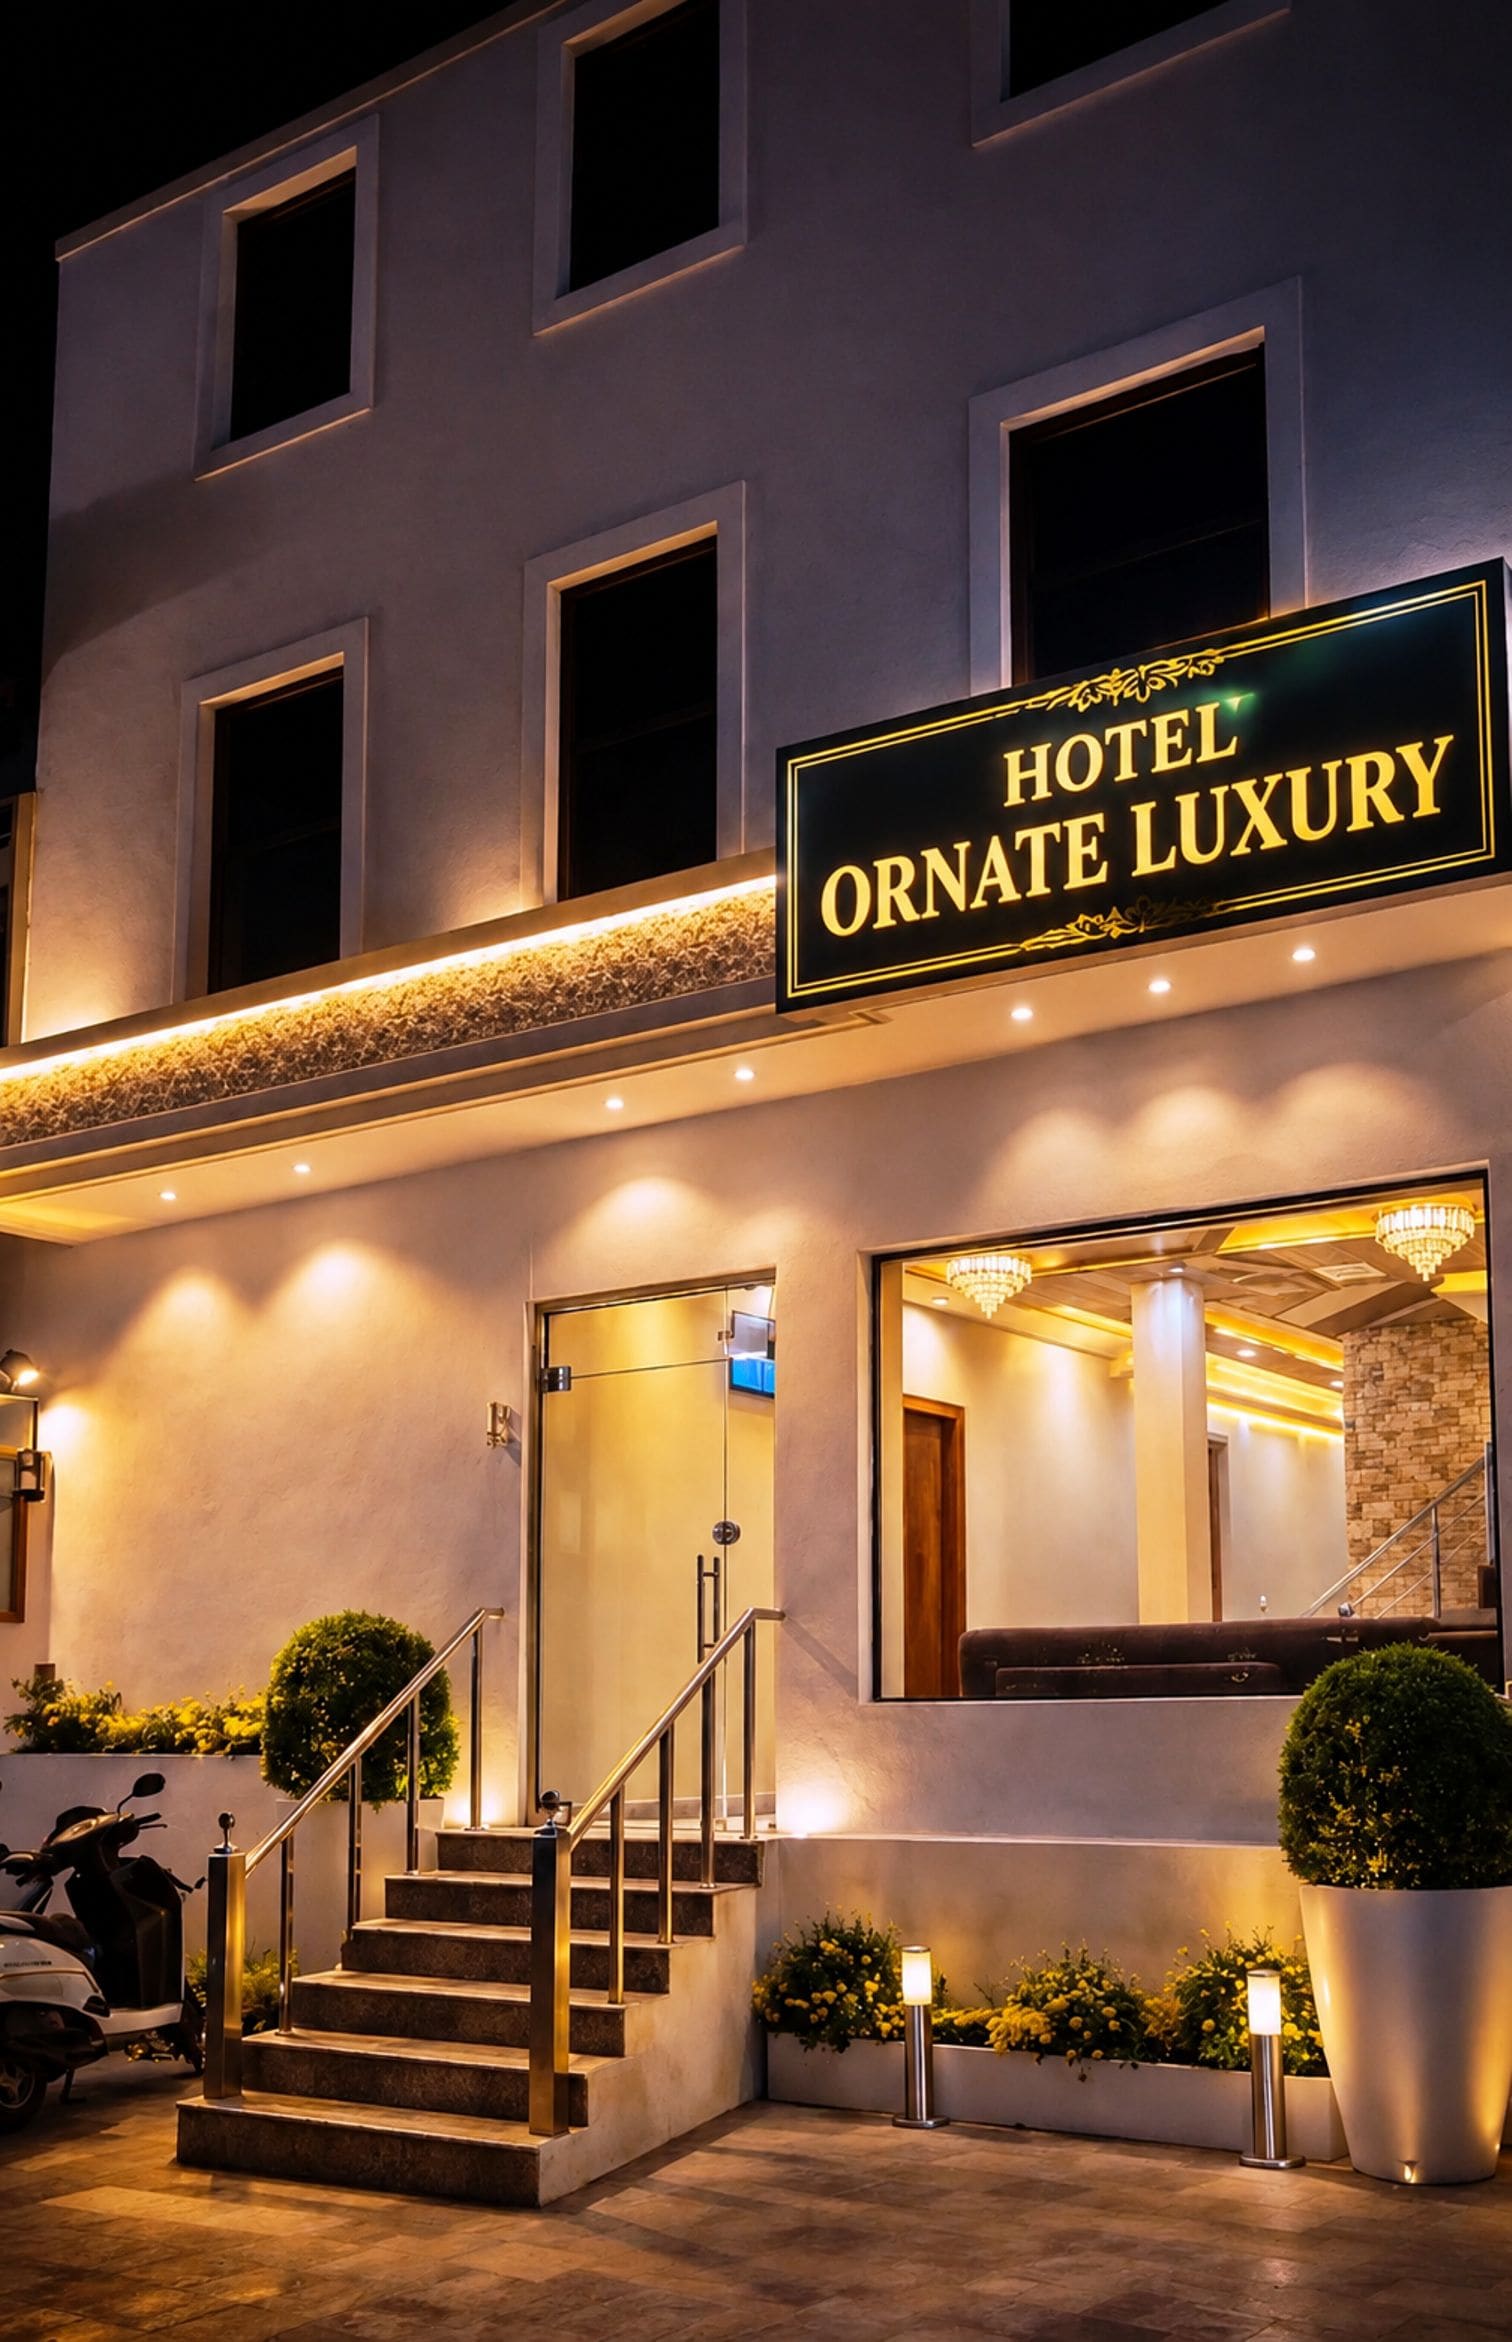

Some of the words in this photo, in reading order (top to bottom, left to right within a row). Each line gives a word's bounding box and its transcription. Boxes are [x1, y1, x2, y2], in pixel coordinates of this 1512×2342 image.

[1003, 701, 1238, 808] HOTEL
[820, 812, 1109, 937] ORNATE
[1130, 734, 1455, 877] LUXURY
